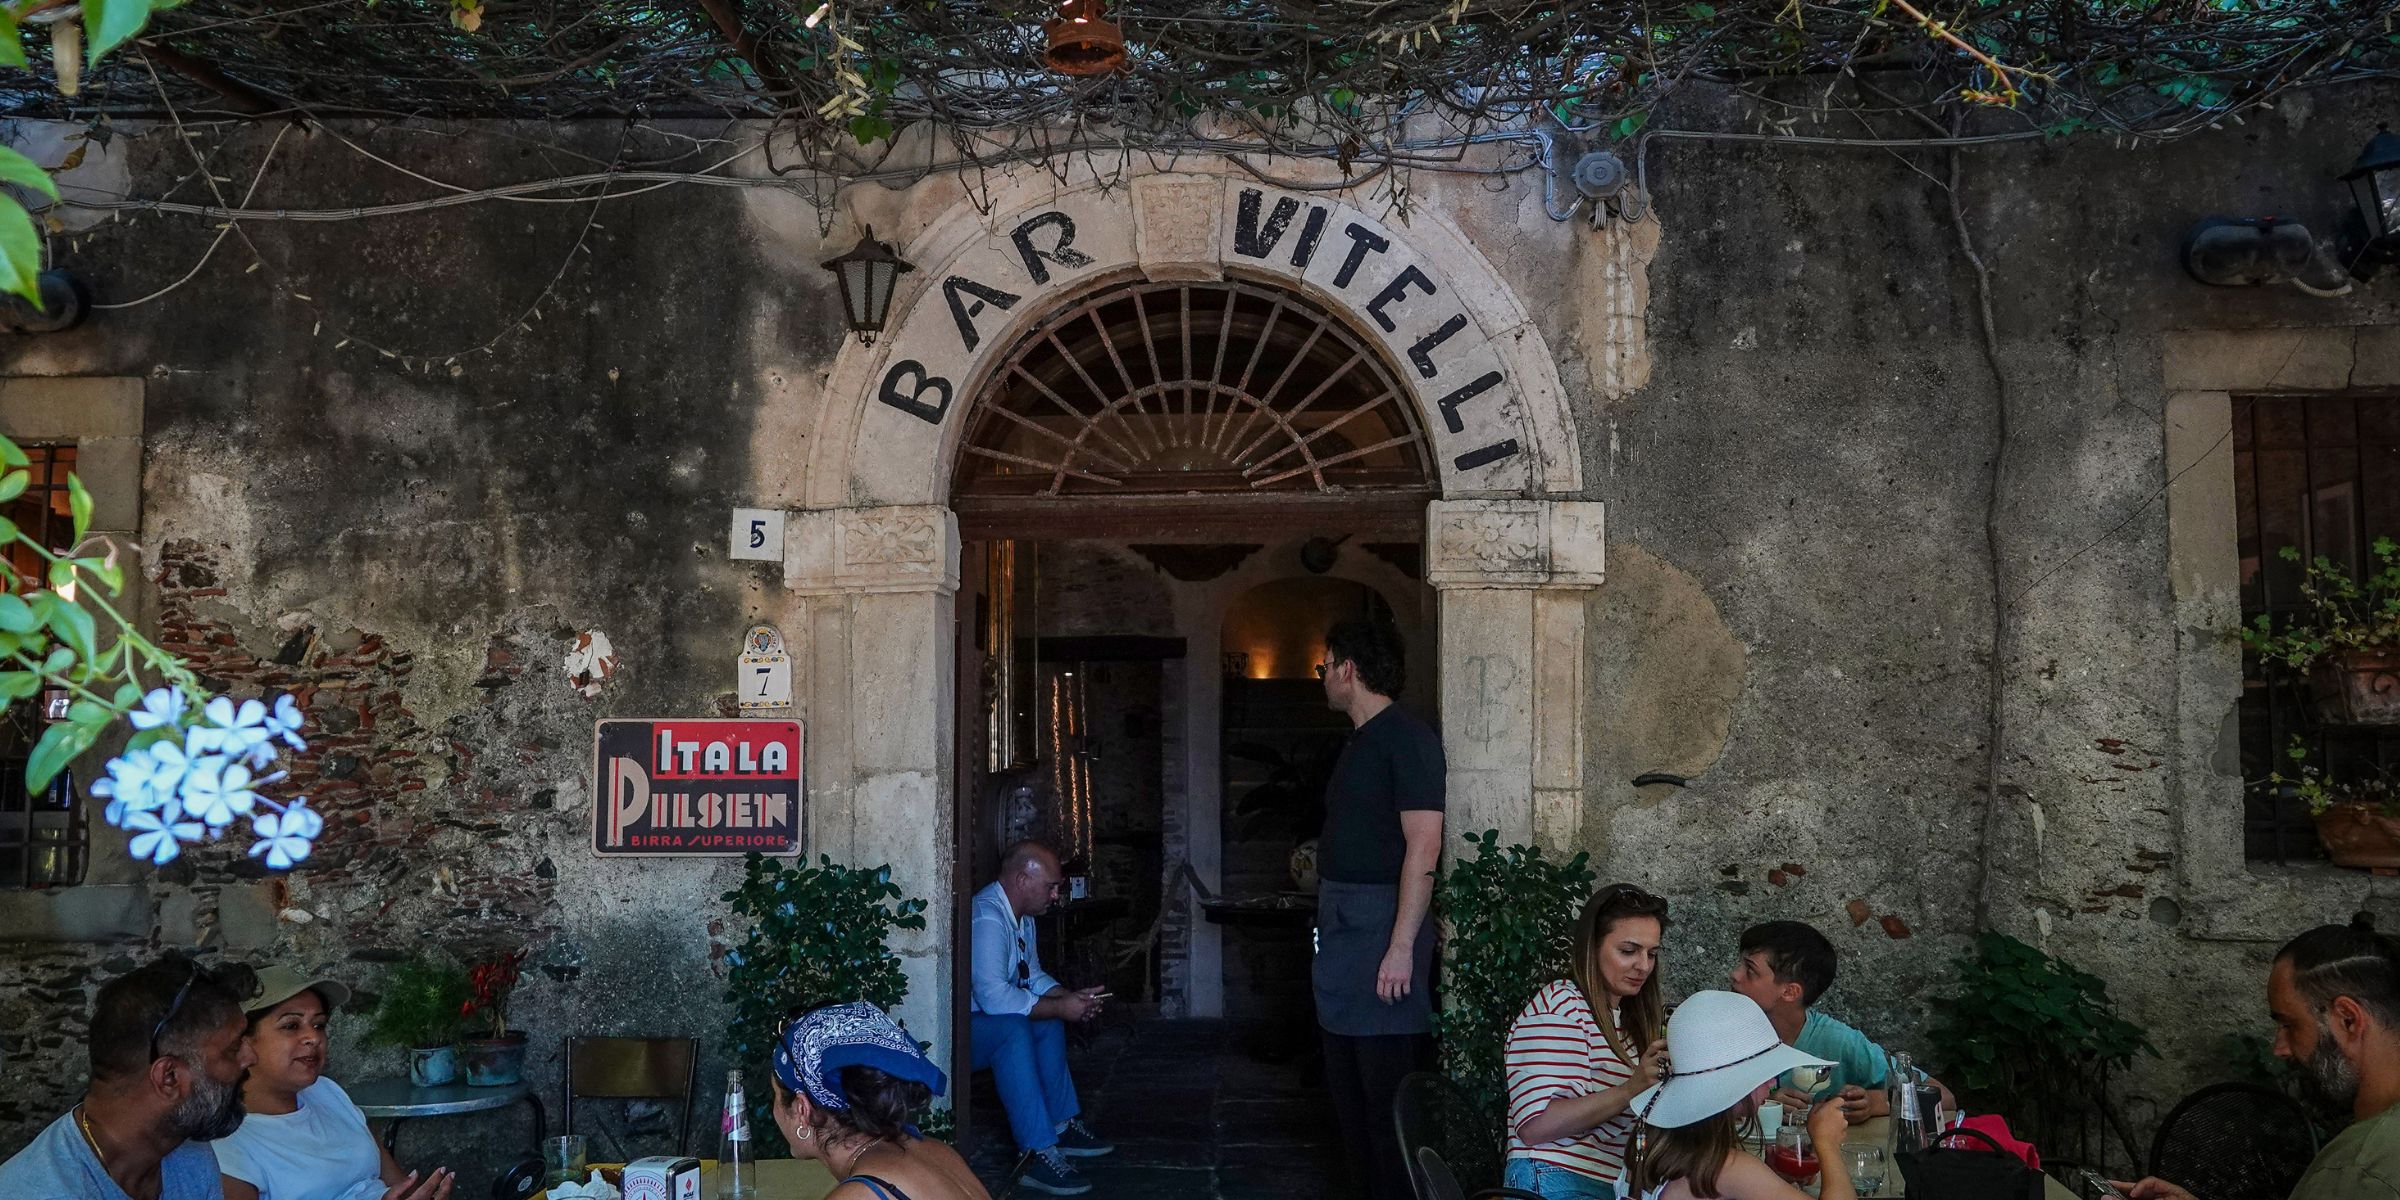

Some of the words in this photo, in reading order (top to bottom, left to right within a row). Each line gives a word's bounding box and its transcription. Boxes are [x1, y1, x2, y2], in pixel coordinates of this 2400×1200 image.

[878, 211, 1096, 426] BAR
[1234, 187, 1519, 472] VITELLI
[750, 519, 767, 549] 5
[756, 667, 772, 697] 7
[658, 729, 788, 773] ITALA
[606, 757, 787, 848] PILSEN
[631, 834, 683, 847] BIRRA
[687, 834, 787, 847] SUPERIORE
